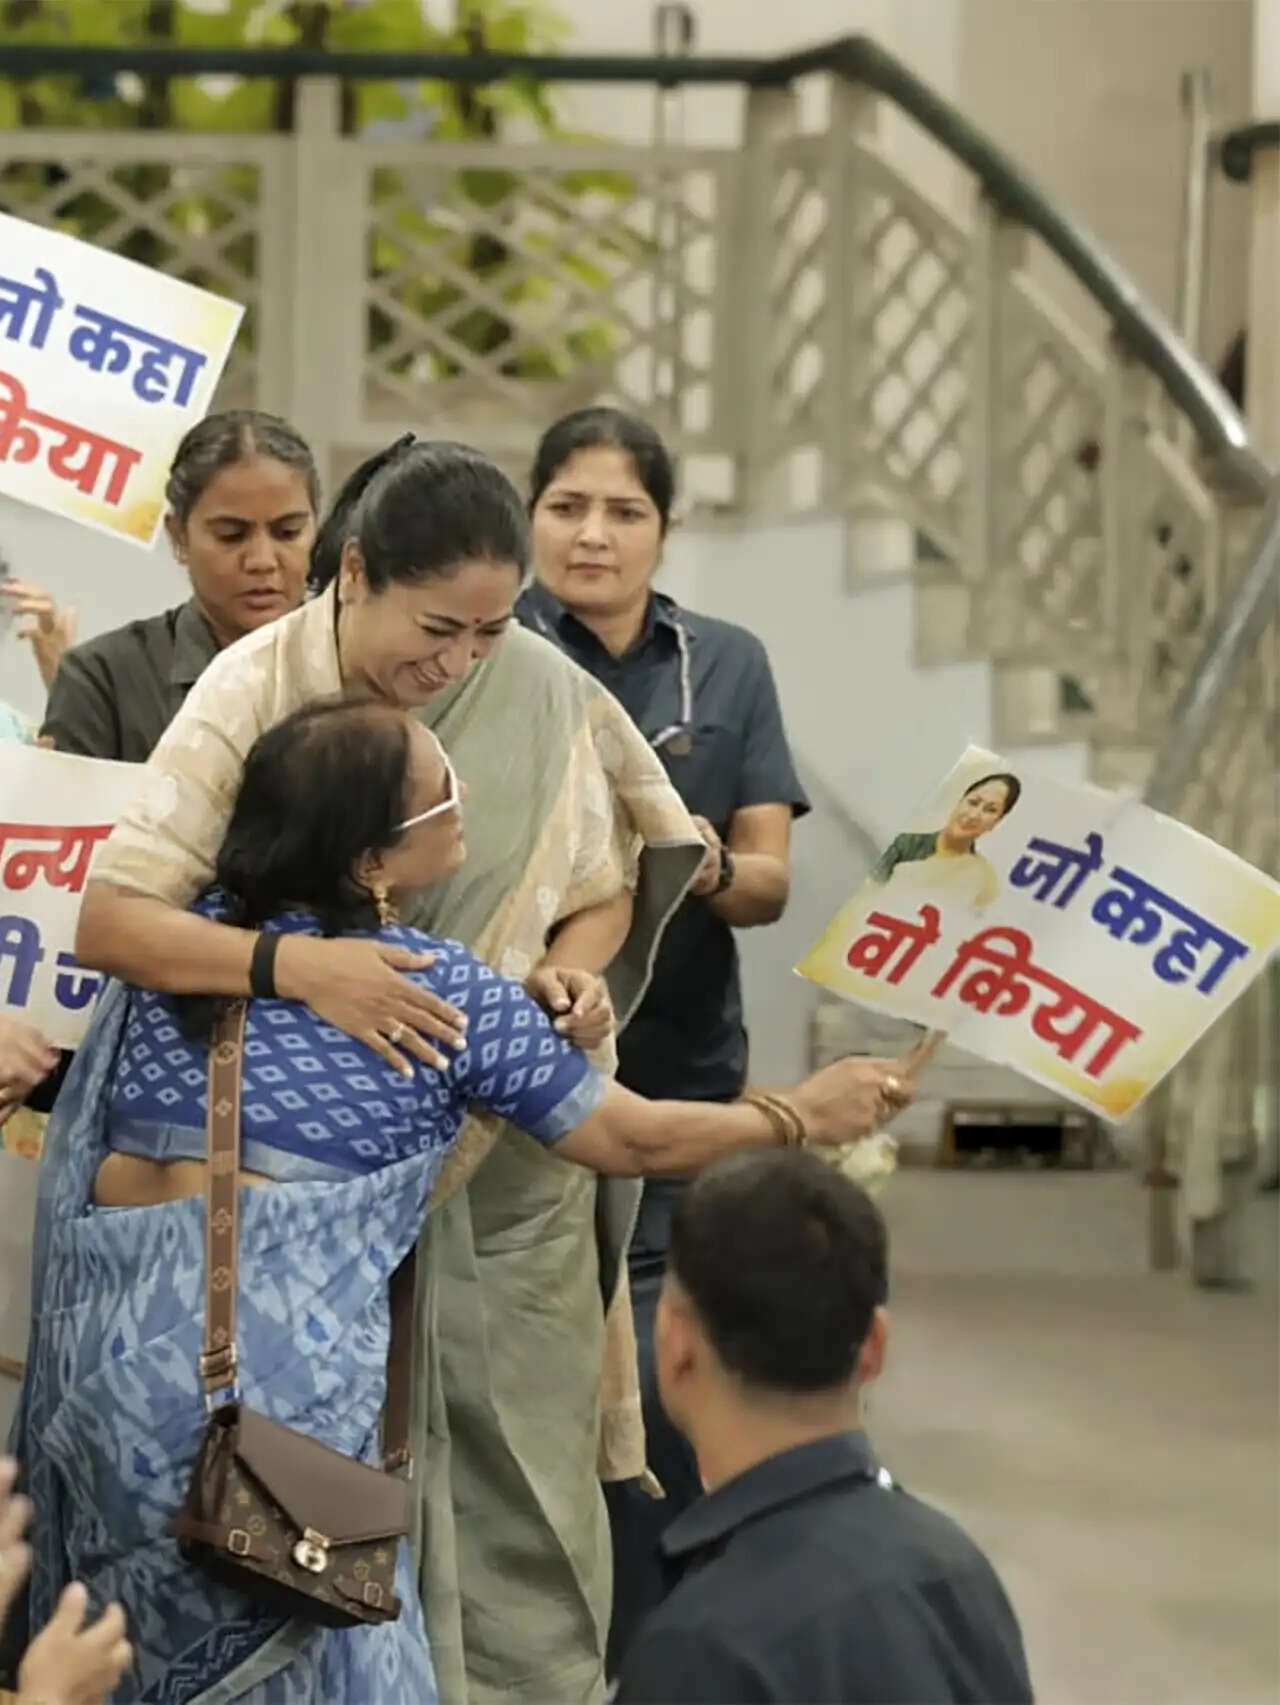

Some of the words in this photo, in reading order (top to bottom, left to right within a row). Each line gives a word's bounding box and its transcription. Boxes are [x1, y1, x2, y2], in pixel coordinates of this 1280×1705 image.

[69, 305, 207, 407] कहा
[847, 904, 941, 985] वो
[930, 926, 1143, 1078] किया
[1009, 832, 1104, 910] जो
[1092, 866, 1250, 995] कहा
